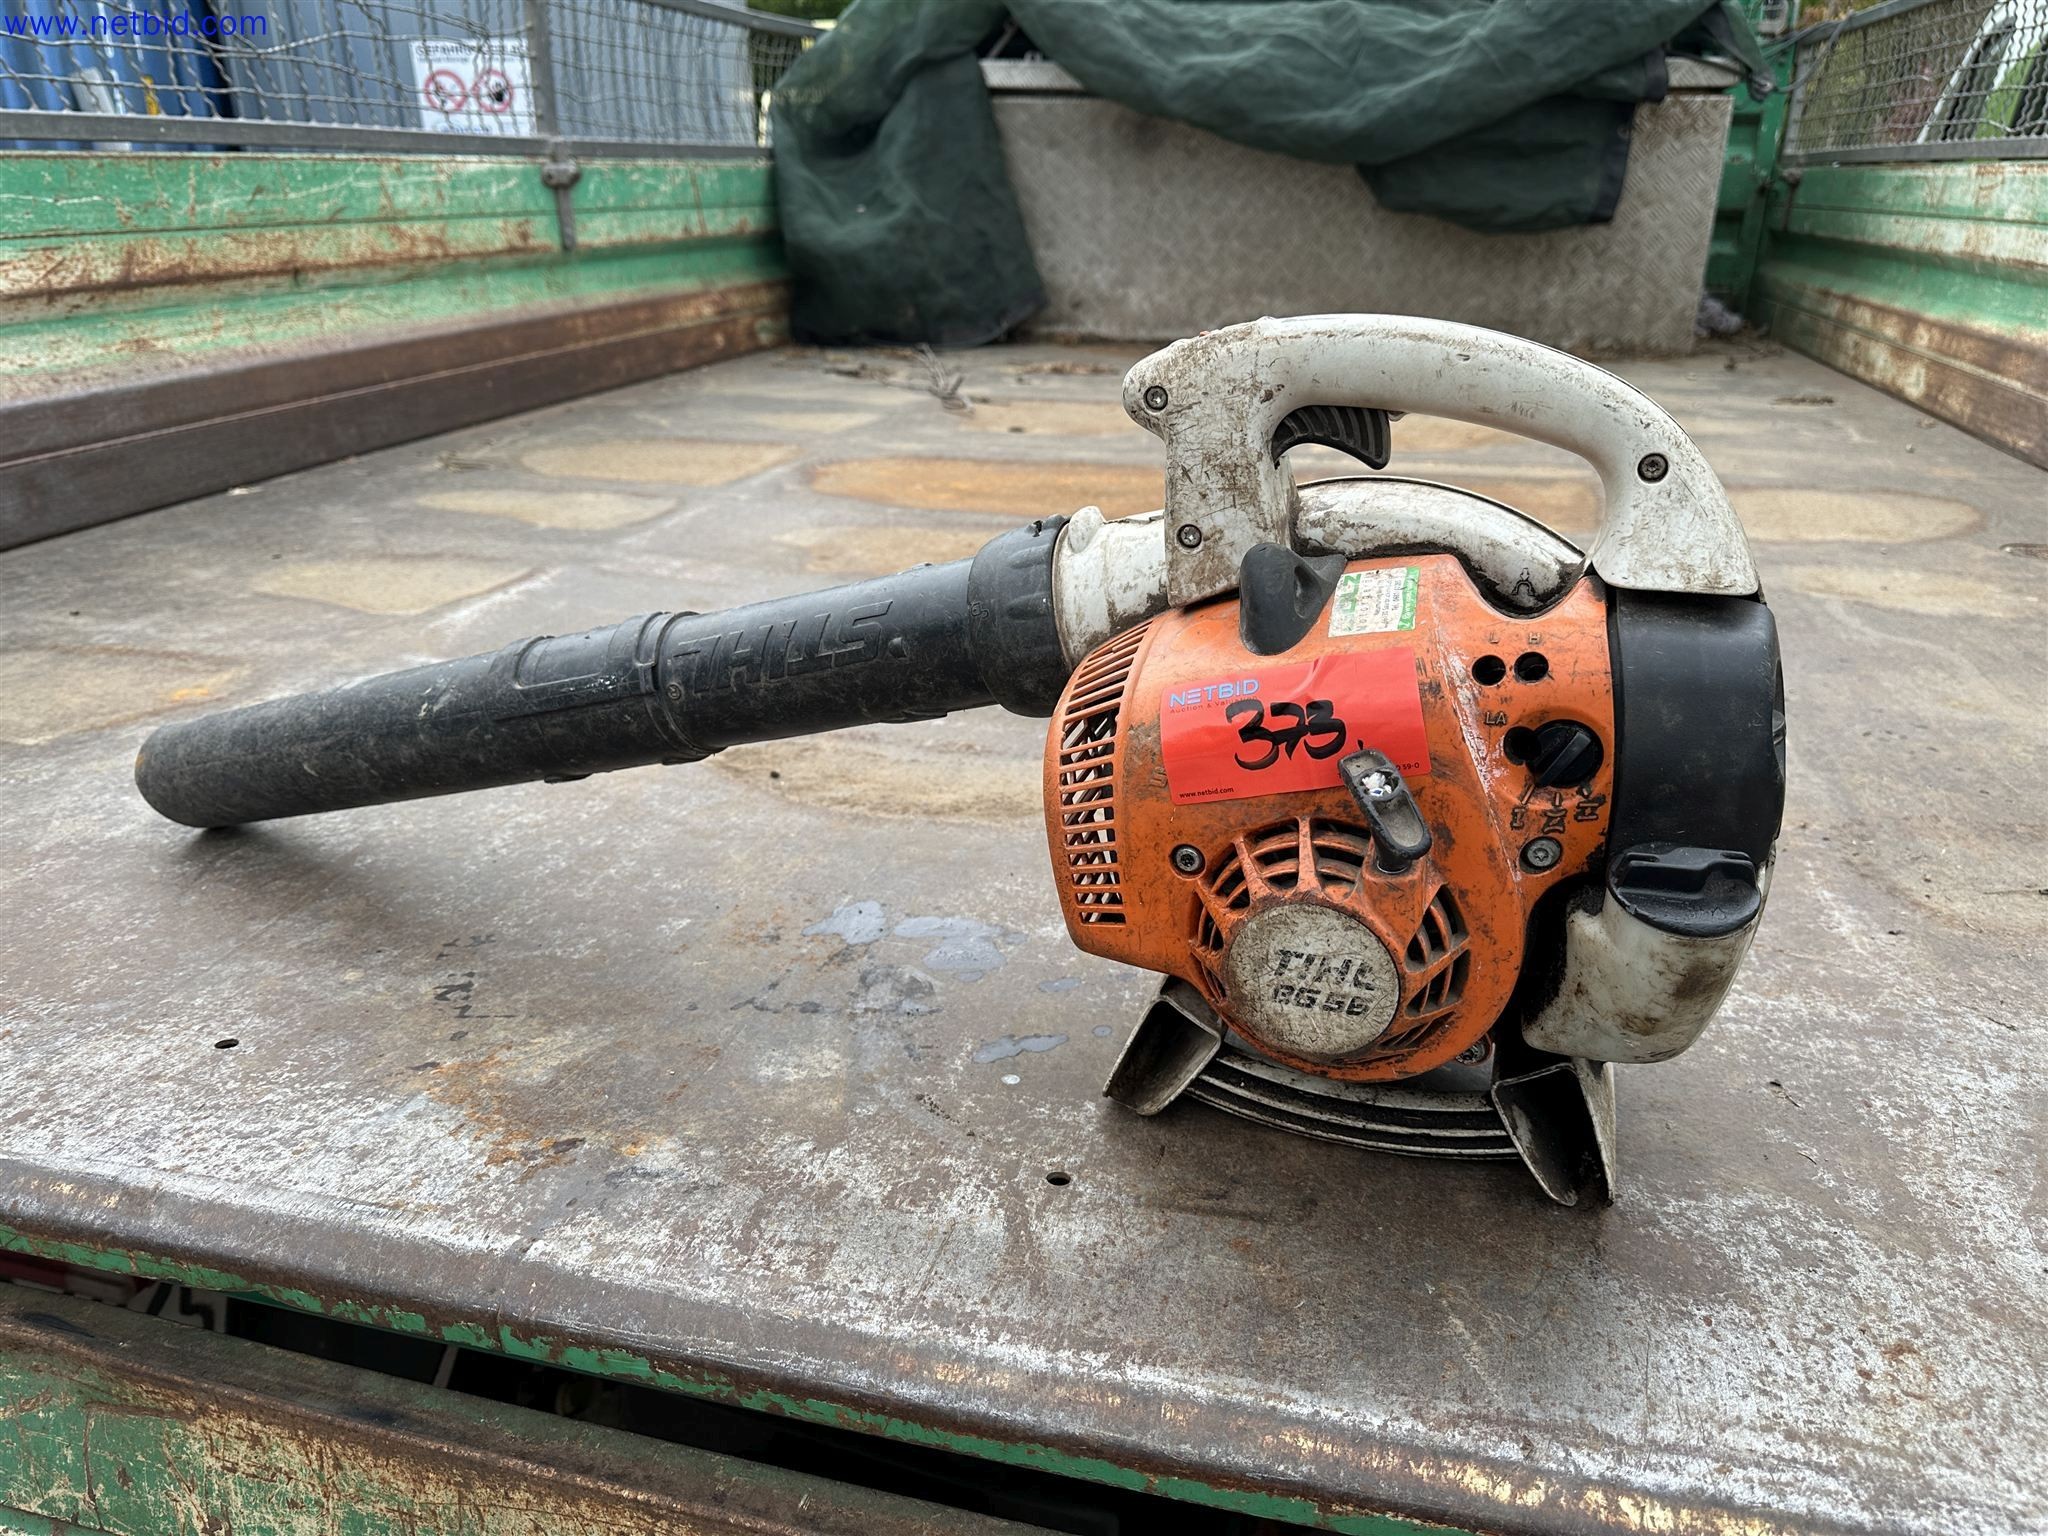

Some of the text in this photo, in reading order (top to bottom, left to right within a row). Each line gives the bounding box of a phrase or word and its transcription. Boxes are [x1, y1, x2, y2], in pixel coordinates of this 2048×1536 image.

[1168, 679, 1260, 708] NETBID
[1485, 711, 1507, 726] LA
[1179, 787, 1234, 798] www.netbid.com
